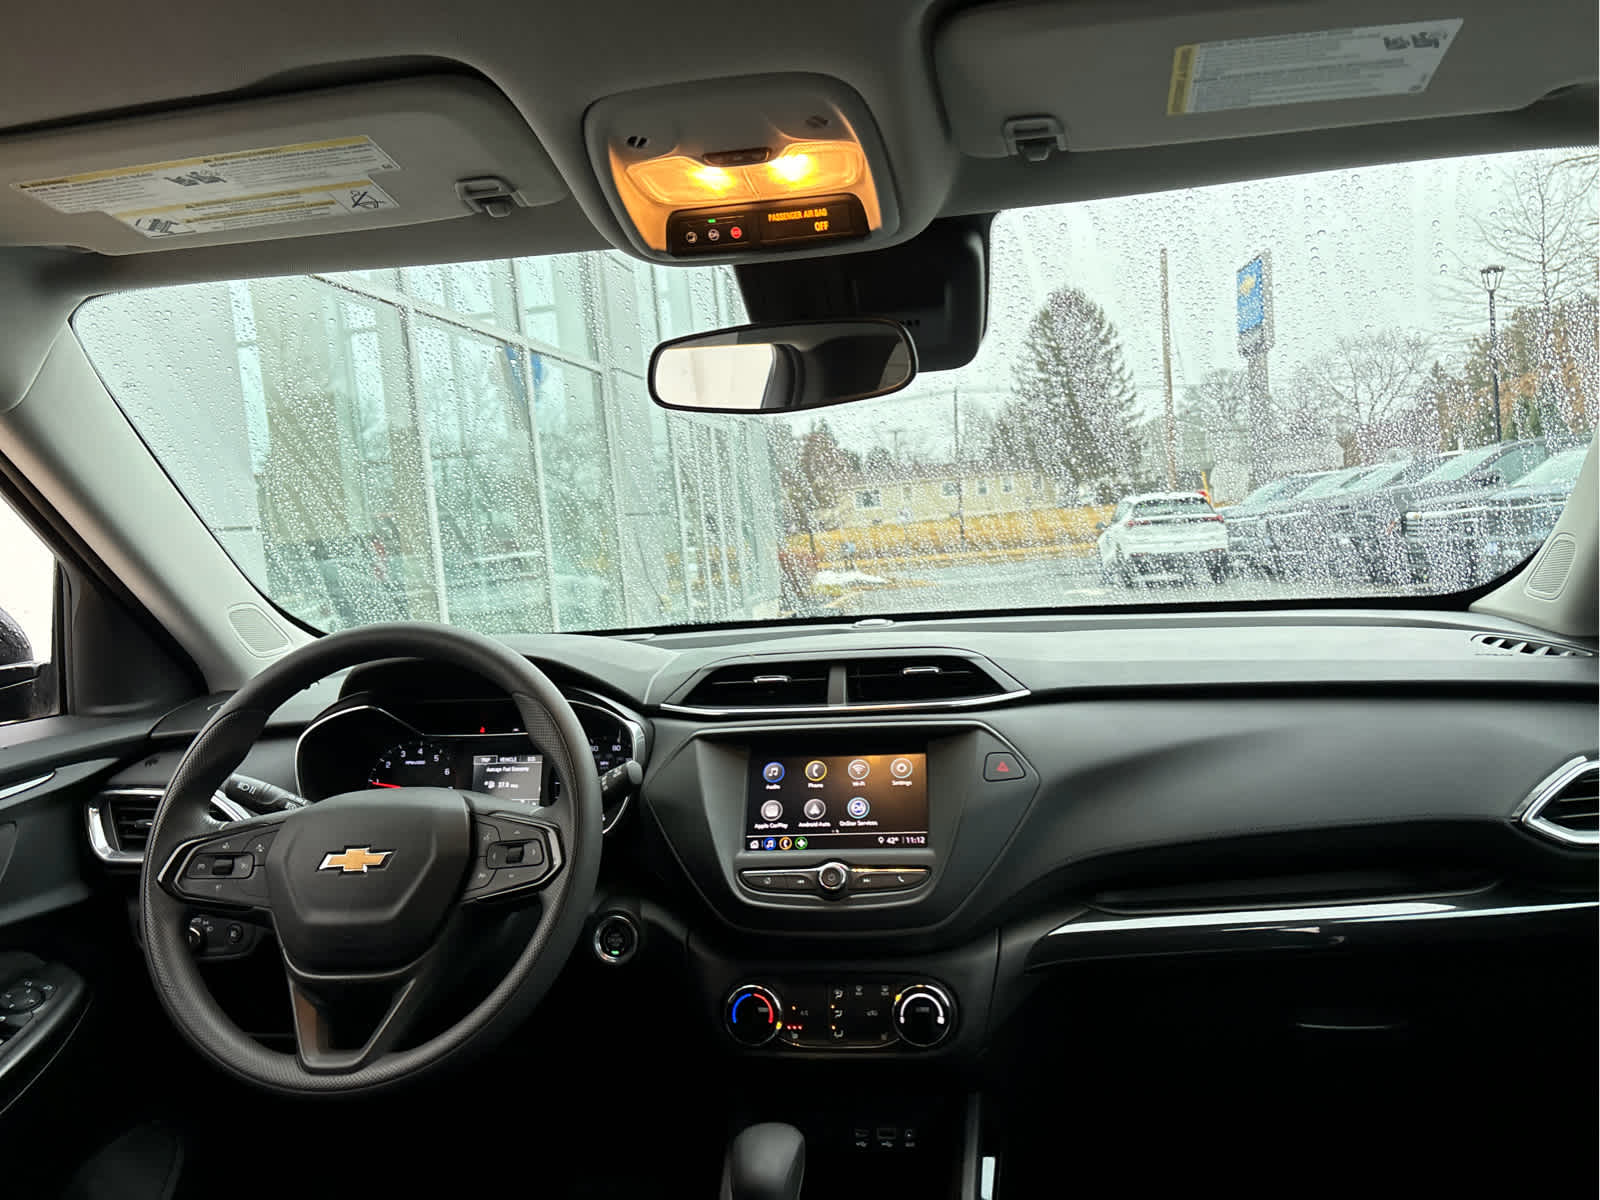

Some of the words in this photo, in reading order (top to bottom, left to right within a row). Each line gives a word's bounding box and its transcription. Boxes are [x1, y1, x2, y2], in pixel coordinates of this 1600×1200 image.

[767, 211, 803, 222] PASSENGER
[804, 209, 814, 218] AIR
[814, 208, 828, 217] BAG
[814, 220, 829, 231] OFF
[417, 747, 424, 755] 4
[611, 744, 622, 752] 80
[400, 750, 407, 758] 3
[433, 754, 440, 762] 5
[385, 760, 392, 769] 2
[443, 767, 451, 776] 6
[891, 779, 913, 787] Settings
[769, 822, 788, 830] CarPlay
[905, 836, 926, 844] 11:12
